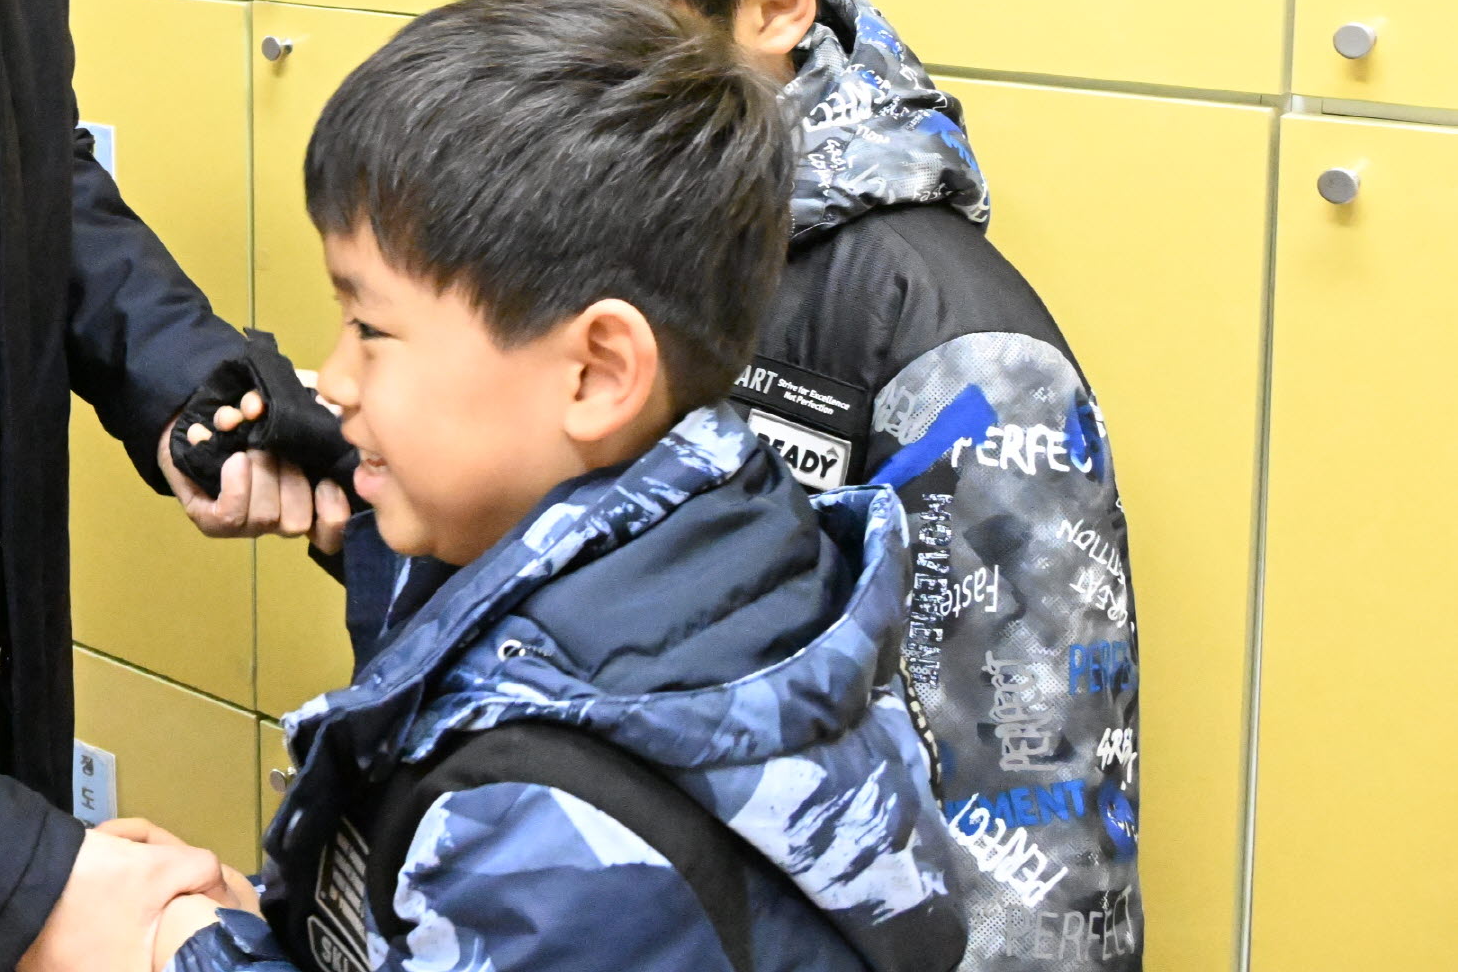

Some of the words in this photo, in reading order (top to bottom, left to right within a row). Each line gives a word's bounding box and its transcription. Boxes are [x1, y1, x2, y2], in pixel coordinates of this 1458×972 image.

[777, 378, 798, 392] Strive
[797, 385, 810, 396] for
[809, 389, 851, 411] Excellence
[783, 391, 797, 404] Not
[796, 395, 834, 416] Perfection
[981, 650, 1059, 772] PERFECT
[1005, 884, 1136, 961] PERFECT
